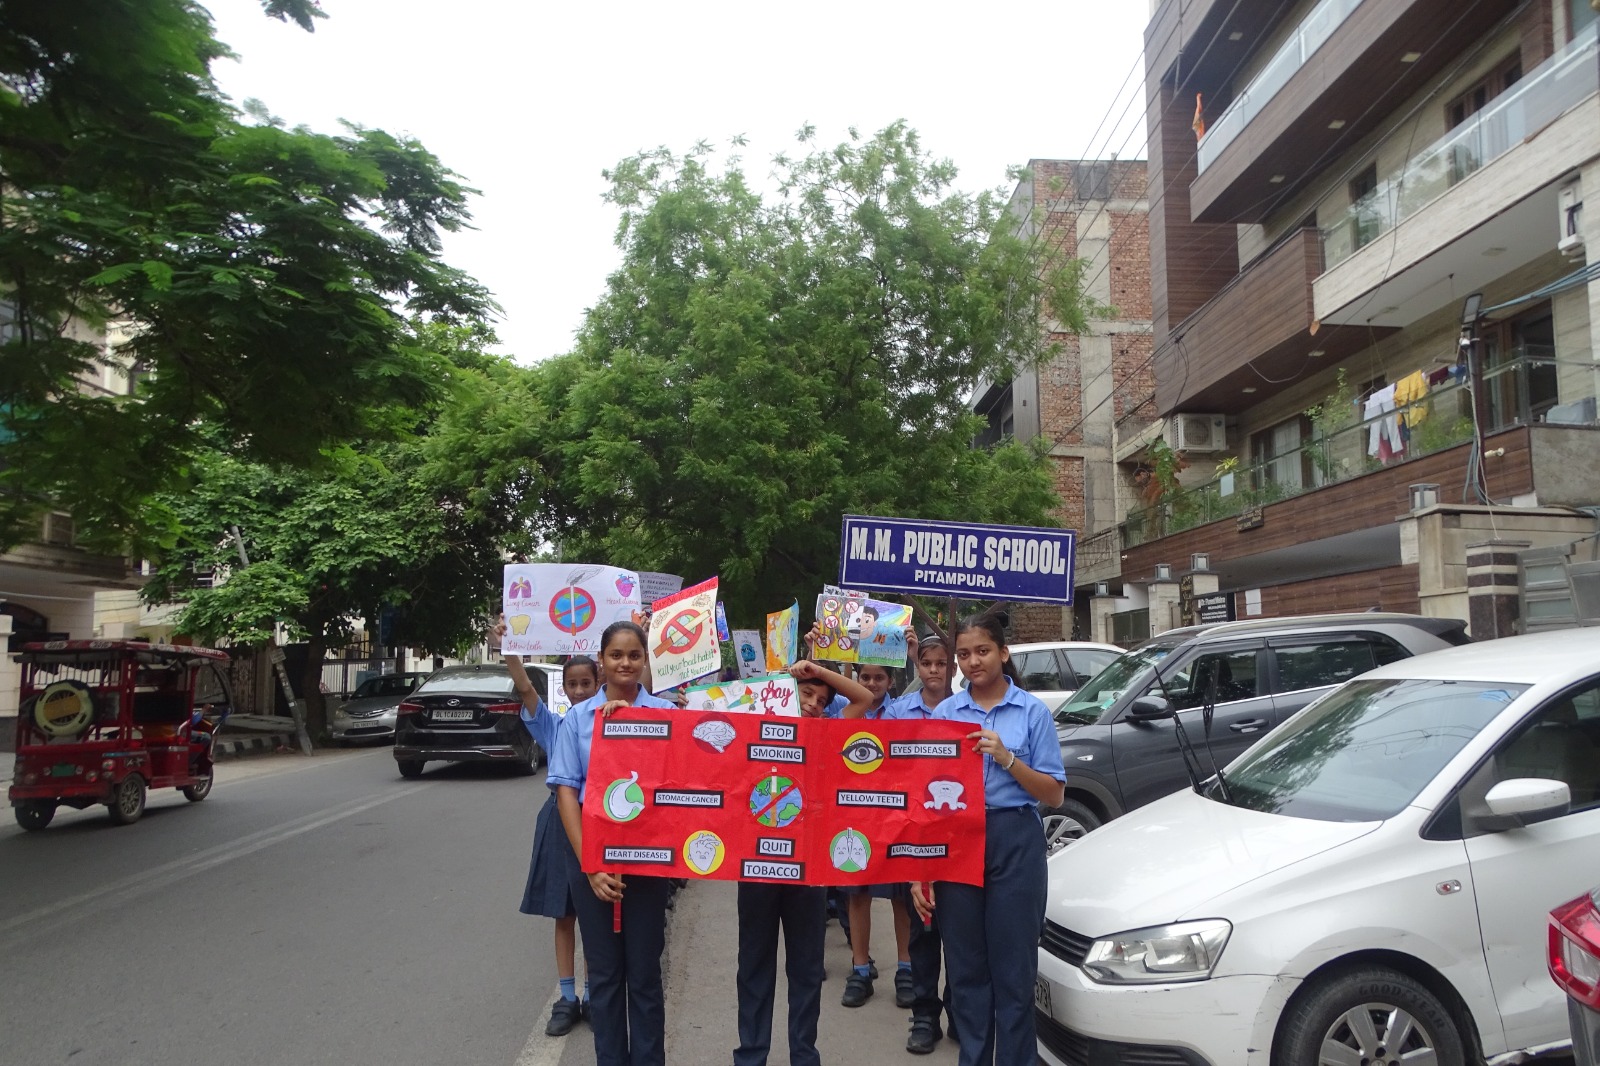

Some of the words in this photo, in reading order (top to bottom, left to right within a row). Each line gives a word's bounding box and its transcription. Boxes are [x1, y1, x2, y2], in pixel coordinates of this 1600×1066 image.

[850, 526, 896, 563] M.M.
[903, 530, 978, 569] PUBLIC
[984, 536, 1066, 575] SCHOOL
[914, 570, 996, 588] PITAMPURA
[555, 640, 571, 653] Say
[572, 638, 588, 652] NO
[682, 653, 697, 668] bad
[690, 662, 714, 678] yourself
[606, 724, 631, 733] BRAIN
[633, 725, 665, 734] STROKE
[764, 726, 792, 738] STOP
[752, 747, 801, 760] SMOKING
[892, 745, 912, 754] EYES
[914, 746, 953, 755] DISEASES
[657, 793, 690, 803] STOMACH
[691, 795, 719, 804] CANCER
[840, 793, 875, 803] YELLOW
[877, 795, 902, 804] TEETH
[761, 840, 790, 853] QUIT
[892, 846, 912, 854] LUNG
[914, 846, 944, 854] CANCER
[607, 850, 632, 859] HEART
[634, 851, 668, 860] DISEASES
[745, 863, 799, 878] TOBACCO
